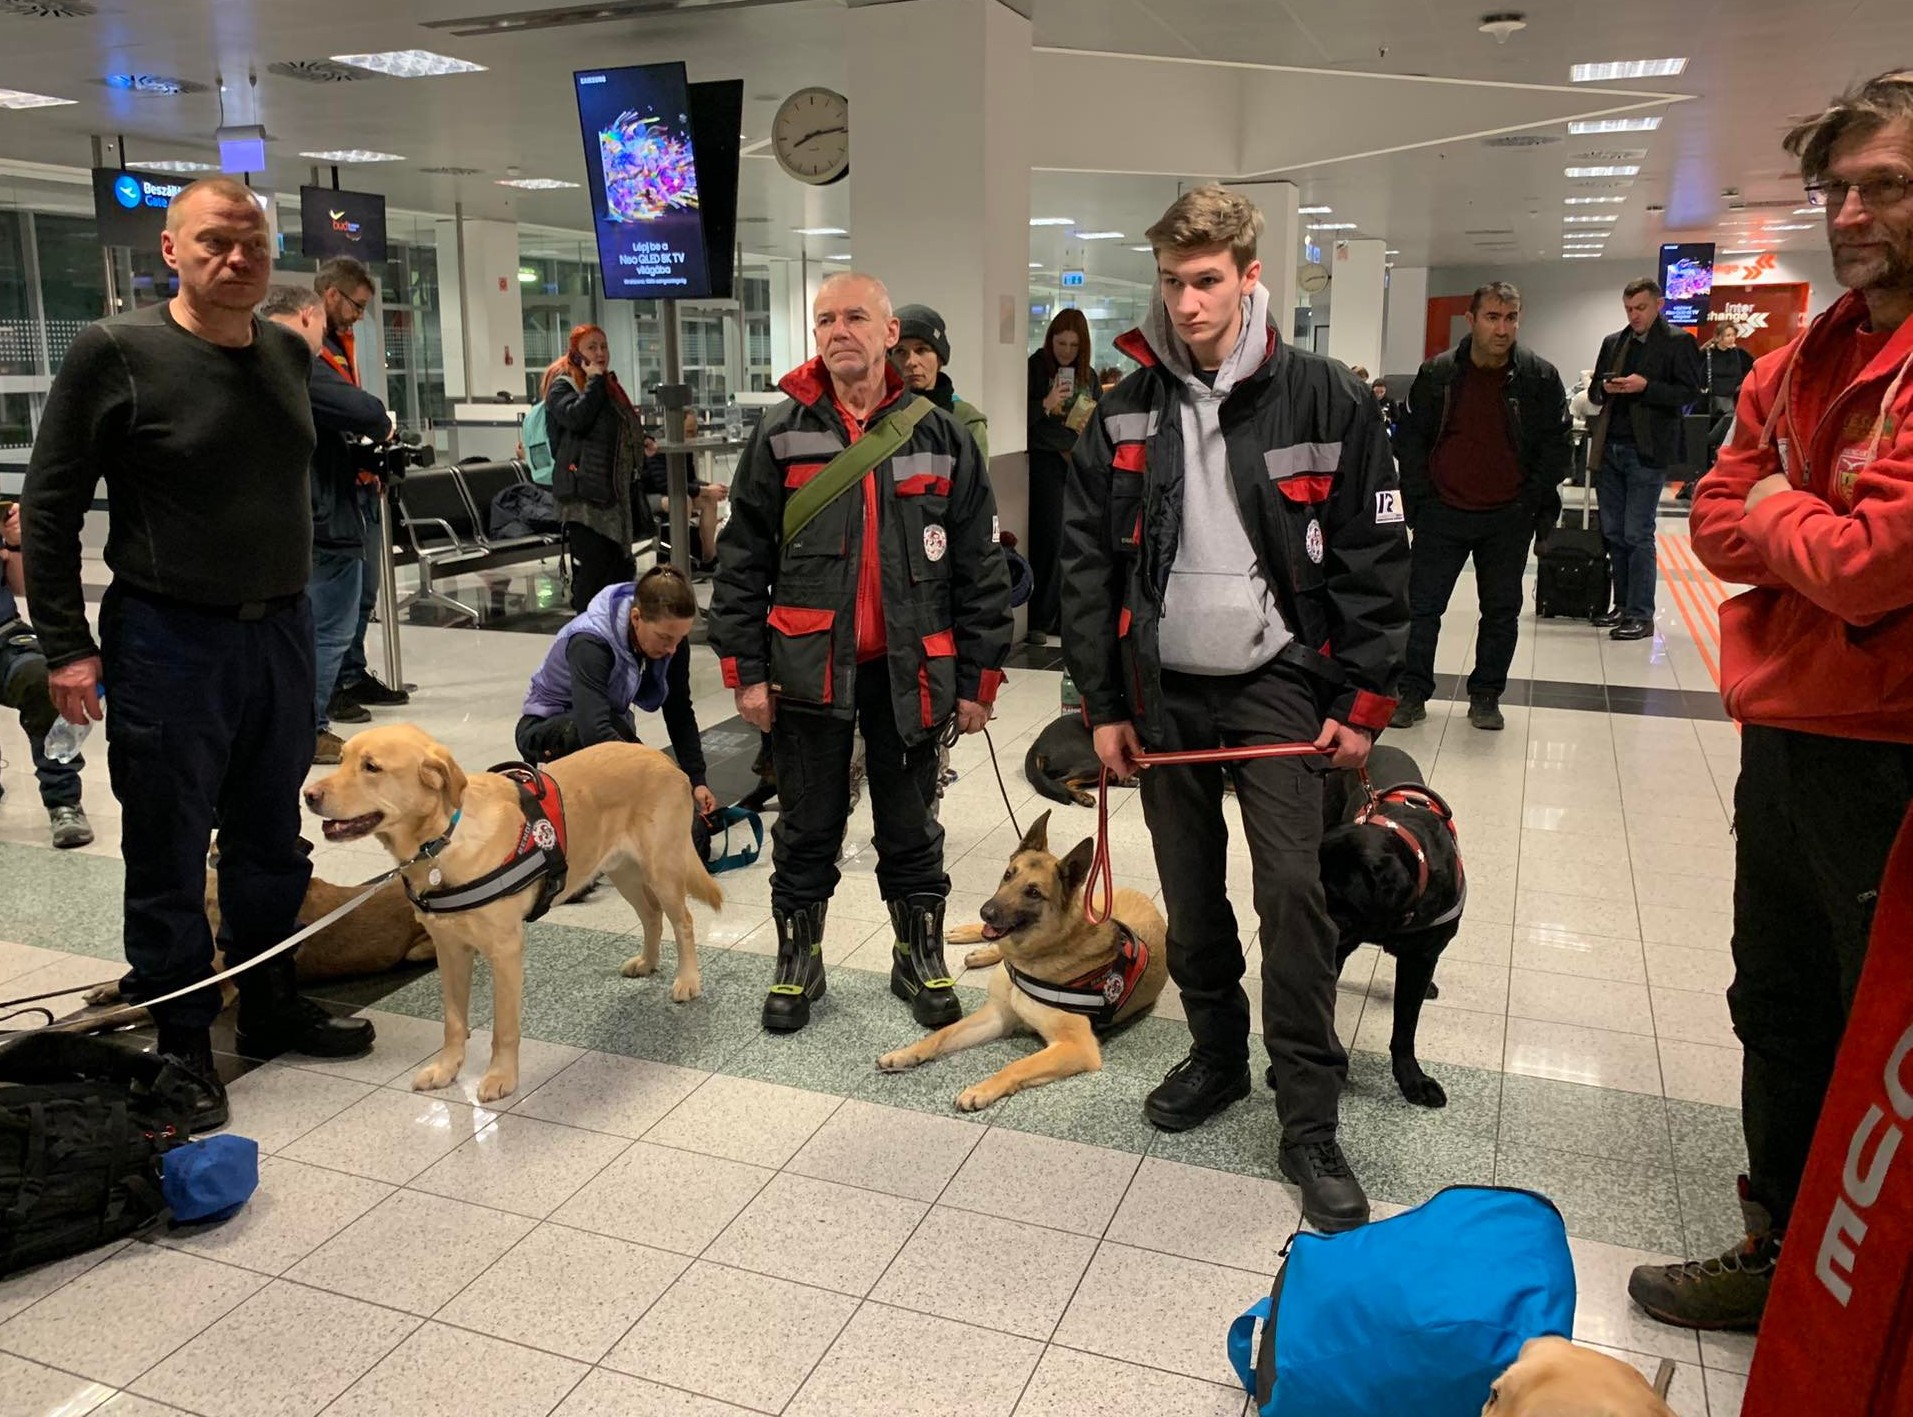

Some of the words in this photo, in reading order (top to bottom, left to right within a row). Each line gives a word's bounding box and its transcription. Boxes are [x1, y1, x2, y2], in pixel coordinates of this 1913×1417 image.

[619, 254, 638, 265] Neo
[672, 252, 685, 263] TV
[1725, 302, 1755, 313] inter
